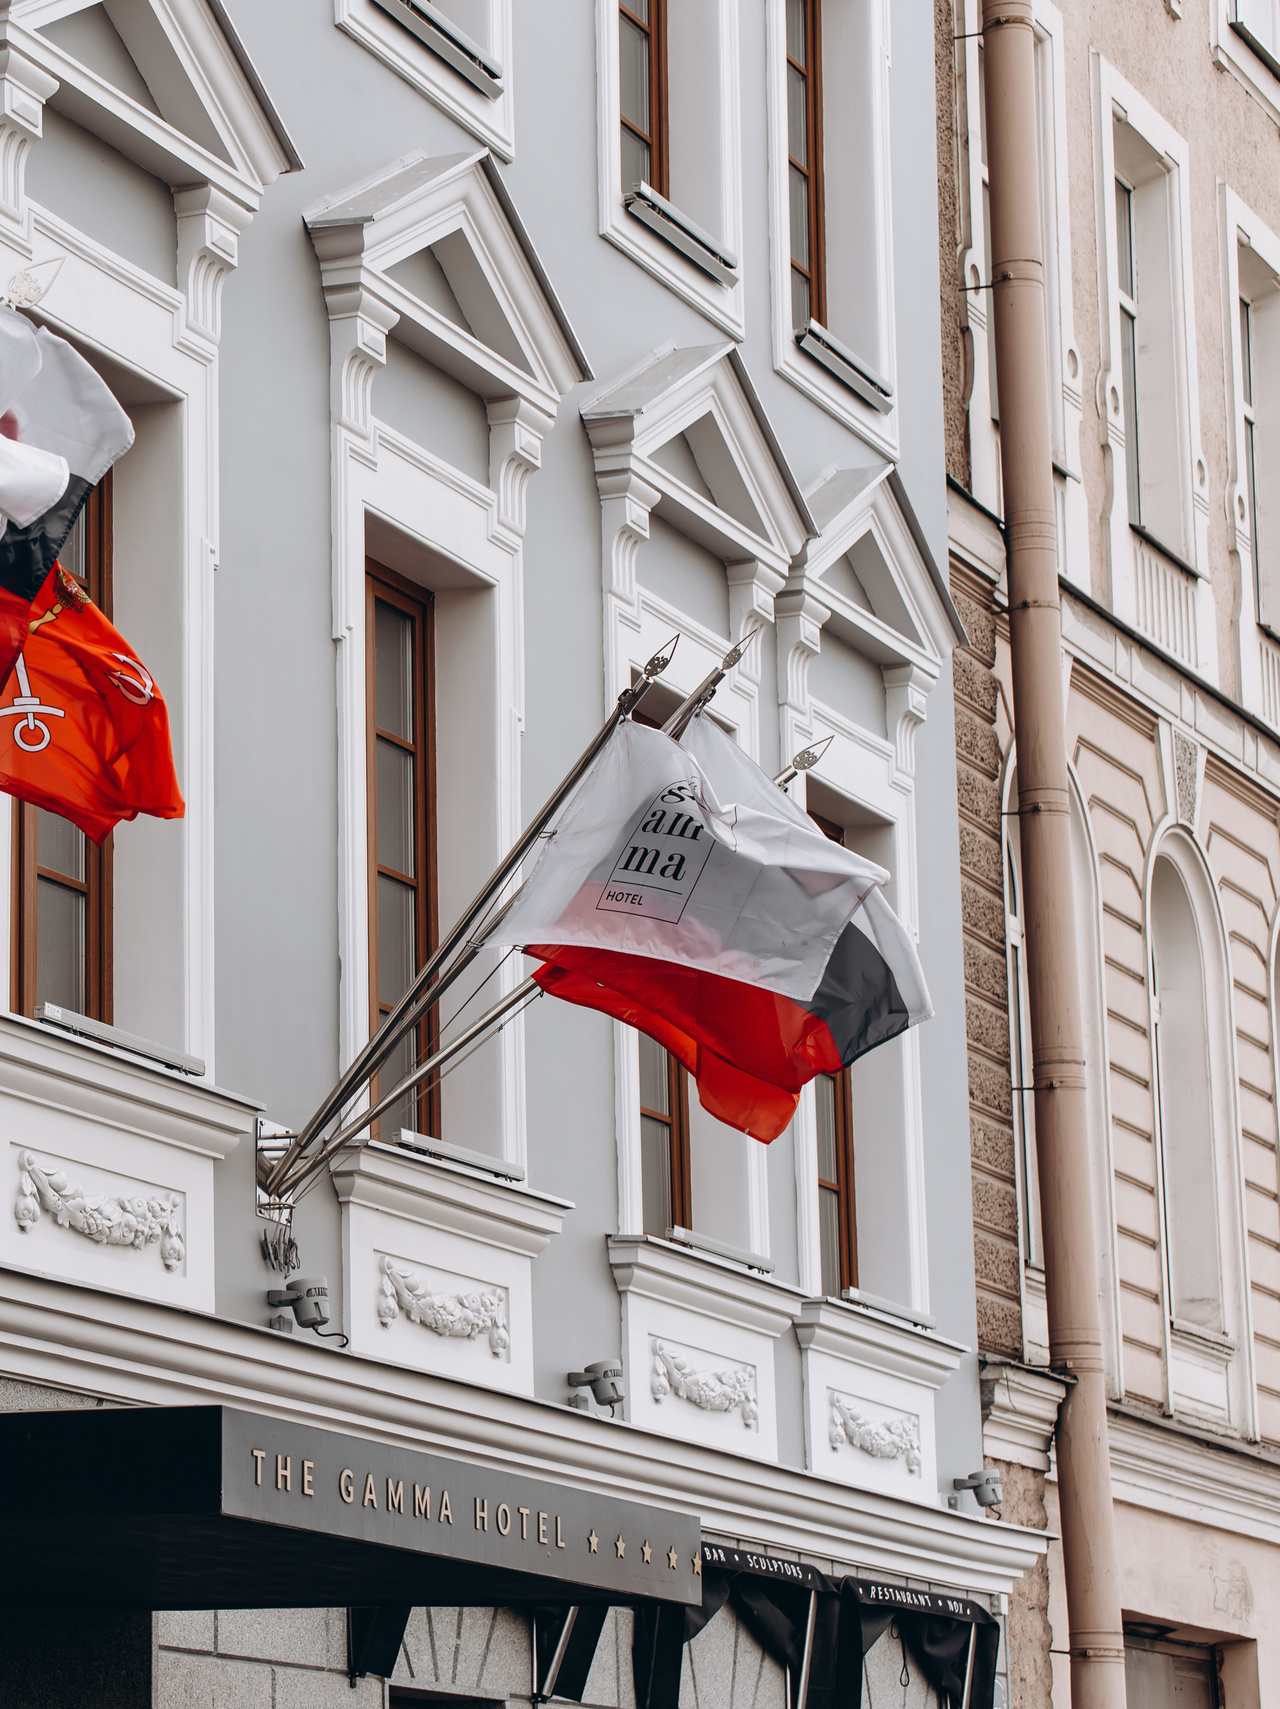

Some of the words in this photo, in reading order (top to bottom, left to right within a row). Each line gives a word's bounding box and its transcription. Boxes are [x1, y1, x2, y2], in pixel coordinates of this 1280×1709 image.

[618, 846, 686, 881] ma
[606, 890, 643, 906] HOTEL
[251, 1449, 315, 1496] THE
[339, 1468, 453, 1524] GAMMA
[474, 1497, 566, 1549] HOTEL
[704, 1547, 726, 1562] BAR
[747, 1555, 803, 1579] SCULPTORS
[870, 1586, 932, 1607] RESTAURANT
